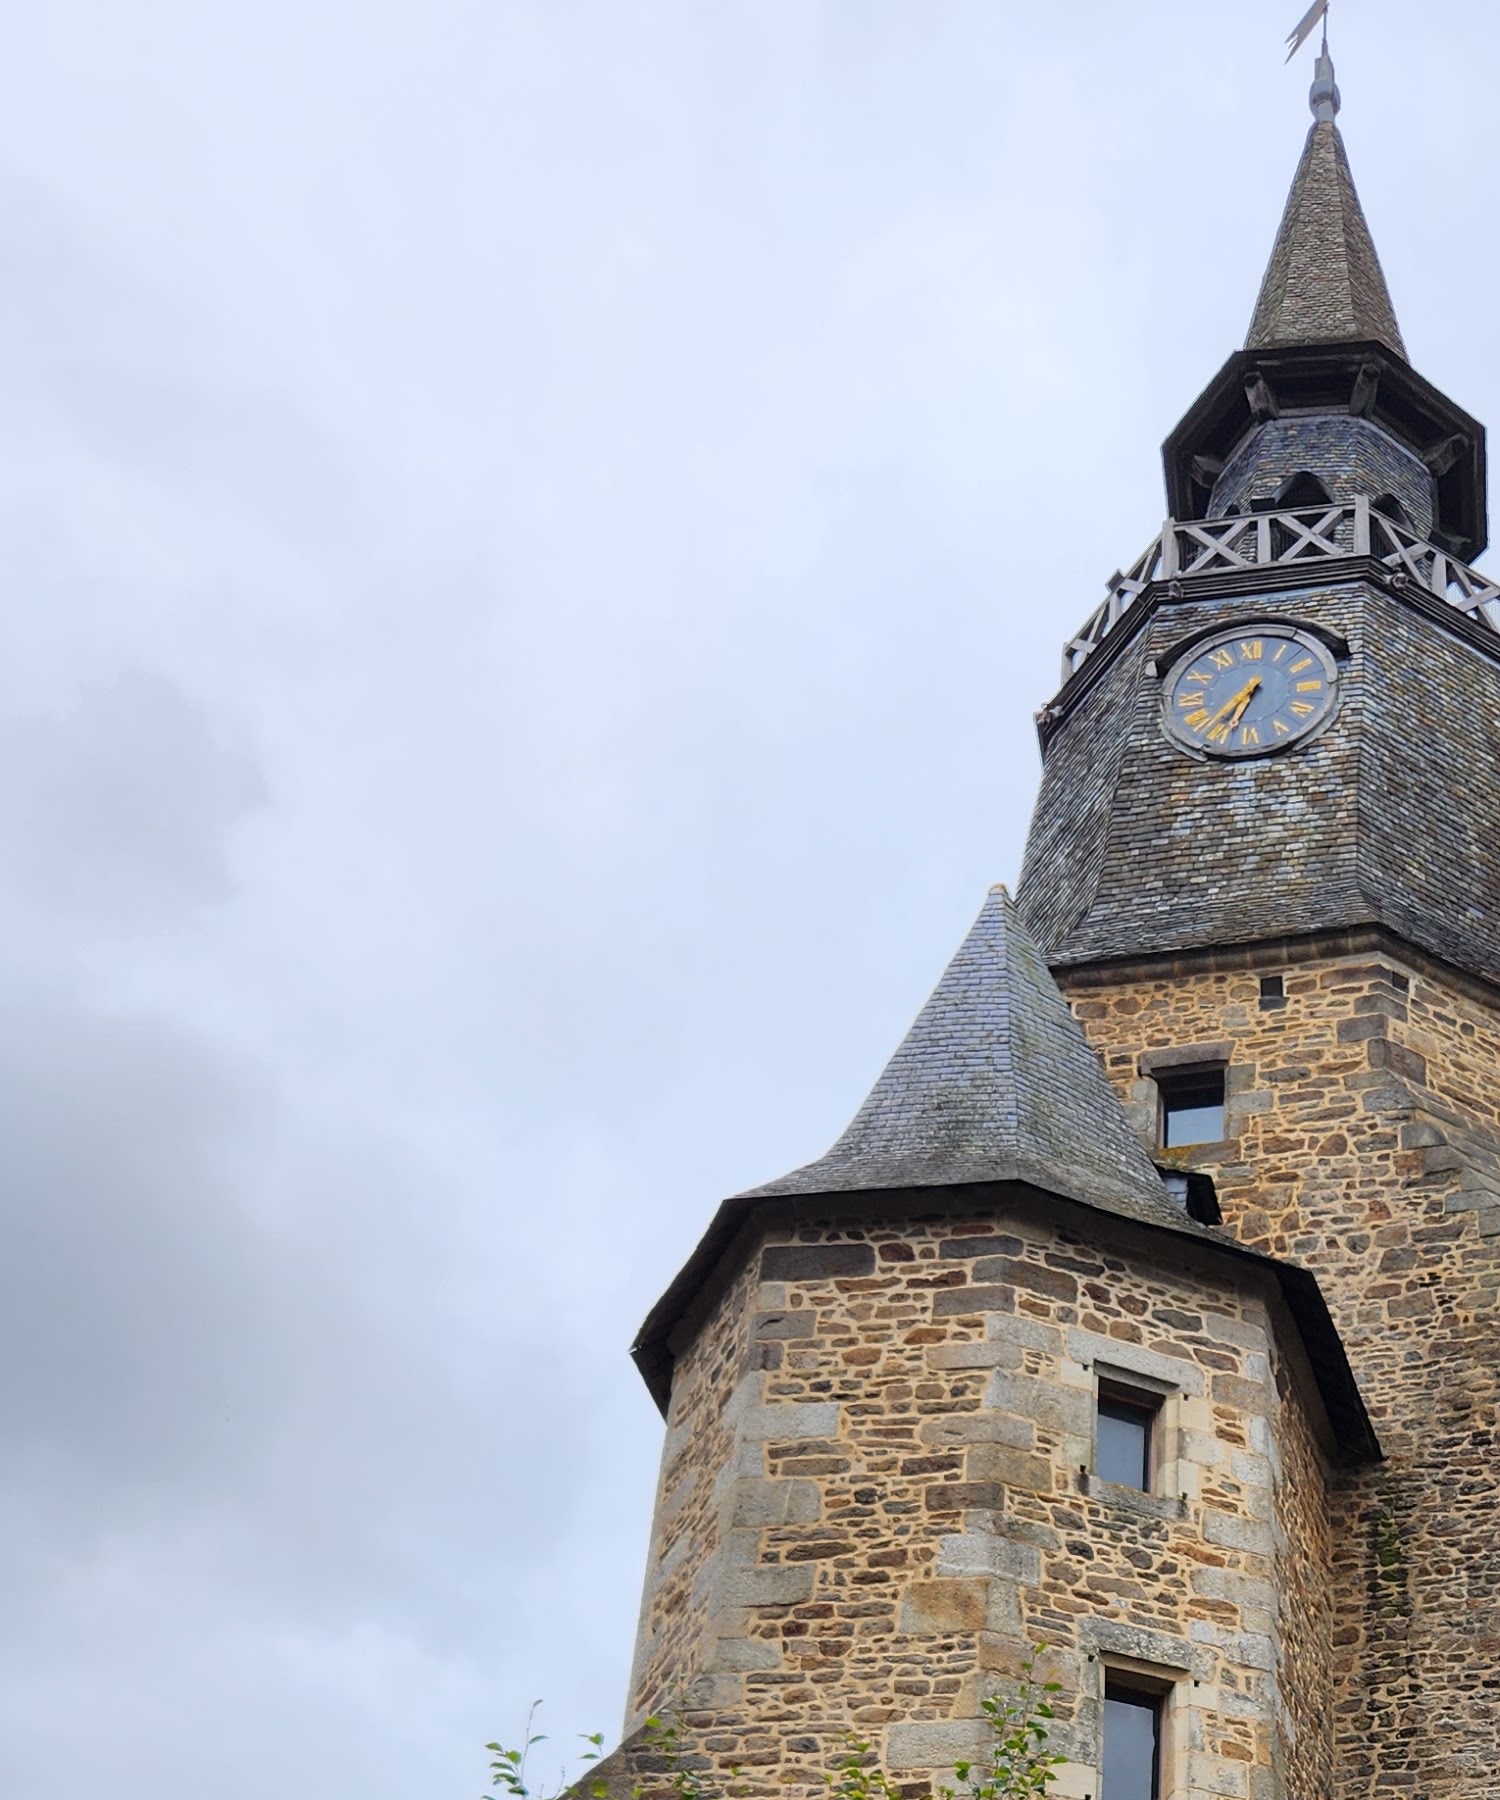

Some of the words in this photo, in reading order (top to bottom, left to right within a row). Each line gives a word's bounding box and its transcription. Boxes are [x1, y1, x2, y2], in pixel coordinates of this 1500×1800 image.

[1241, 641, 1262, 659] XII
[1272, 644, 1287, 662] I
[1208, 649, 1233, 670] XI
[1186, 670, 1213, 685] X
[1178, 691, 1204, 706] IX
[1242, 726, 1259, 745] VI
[1273, 720, 1290, 736] V
